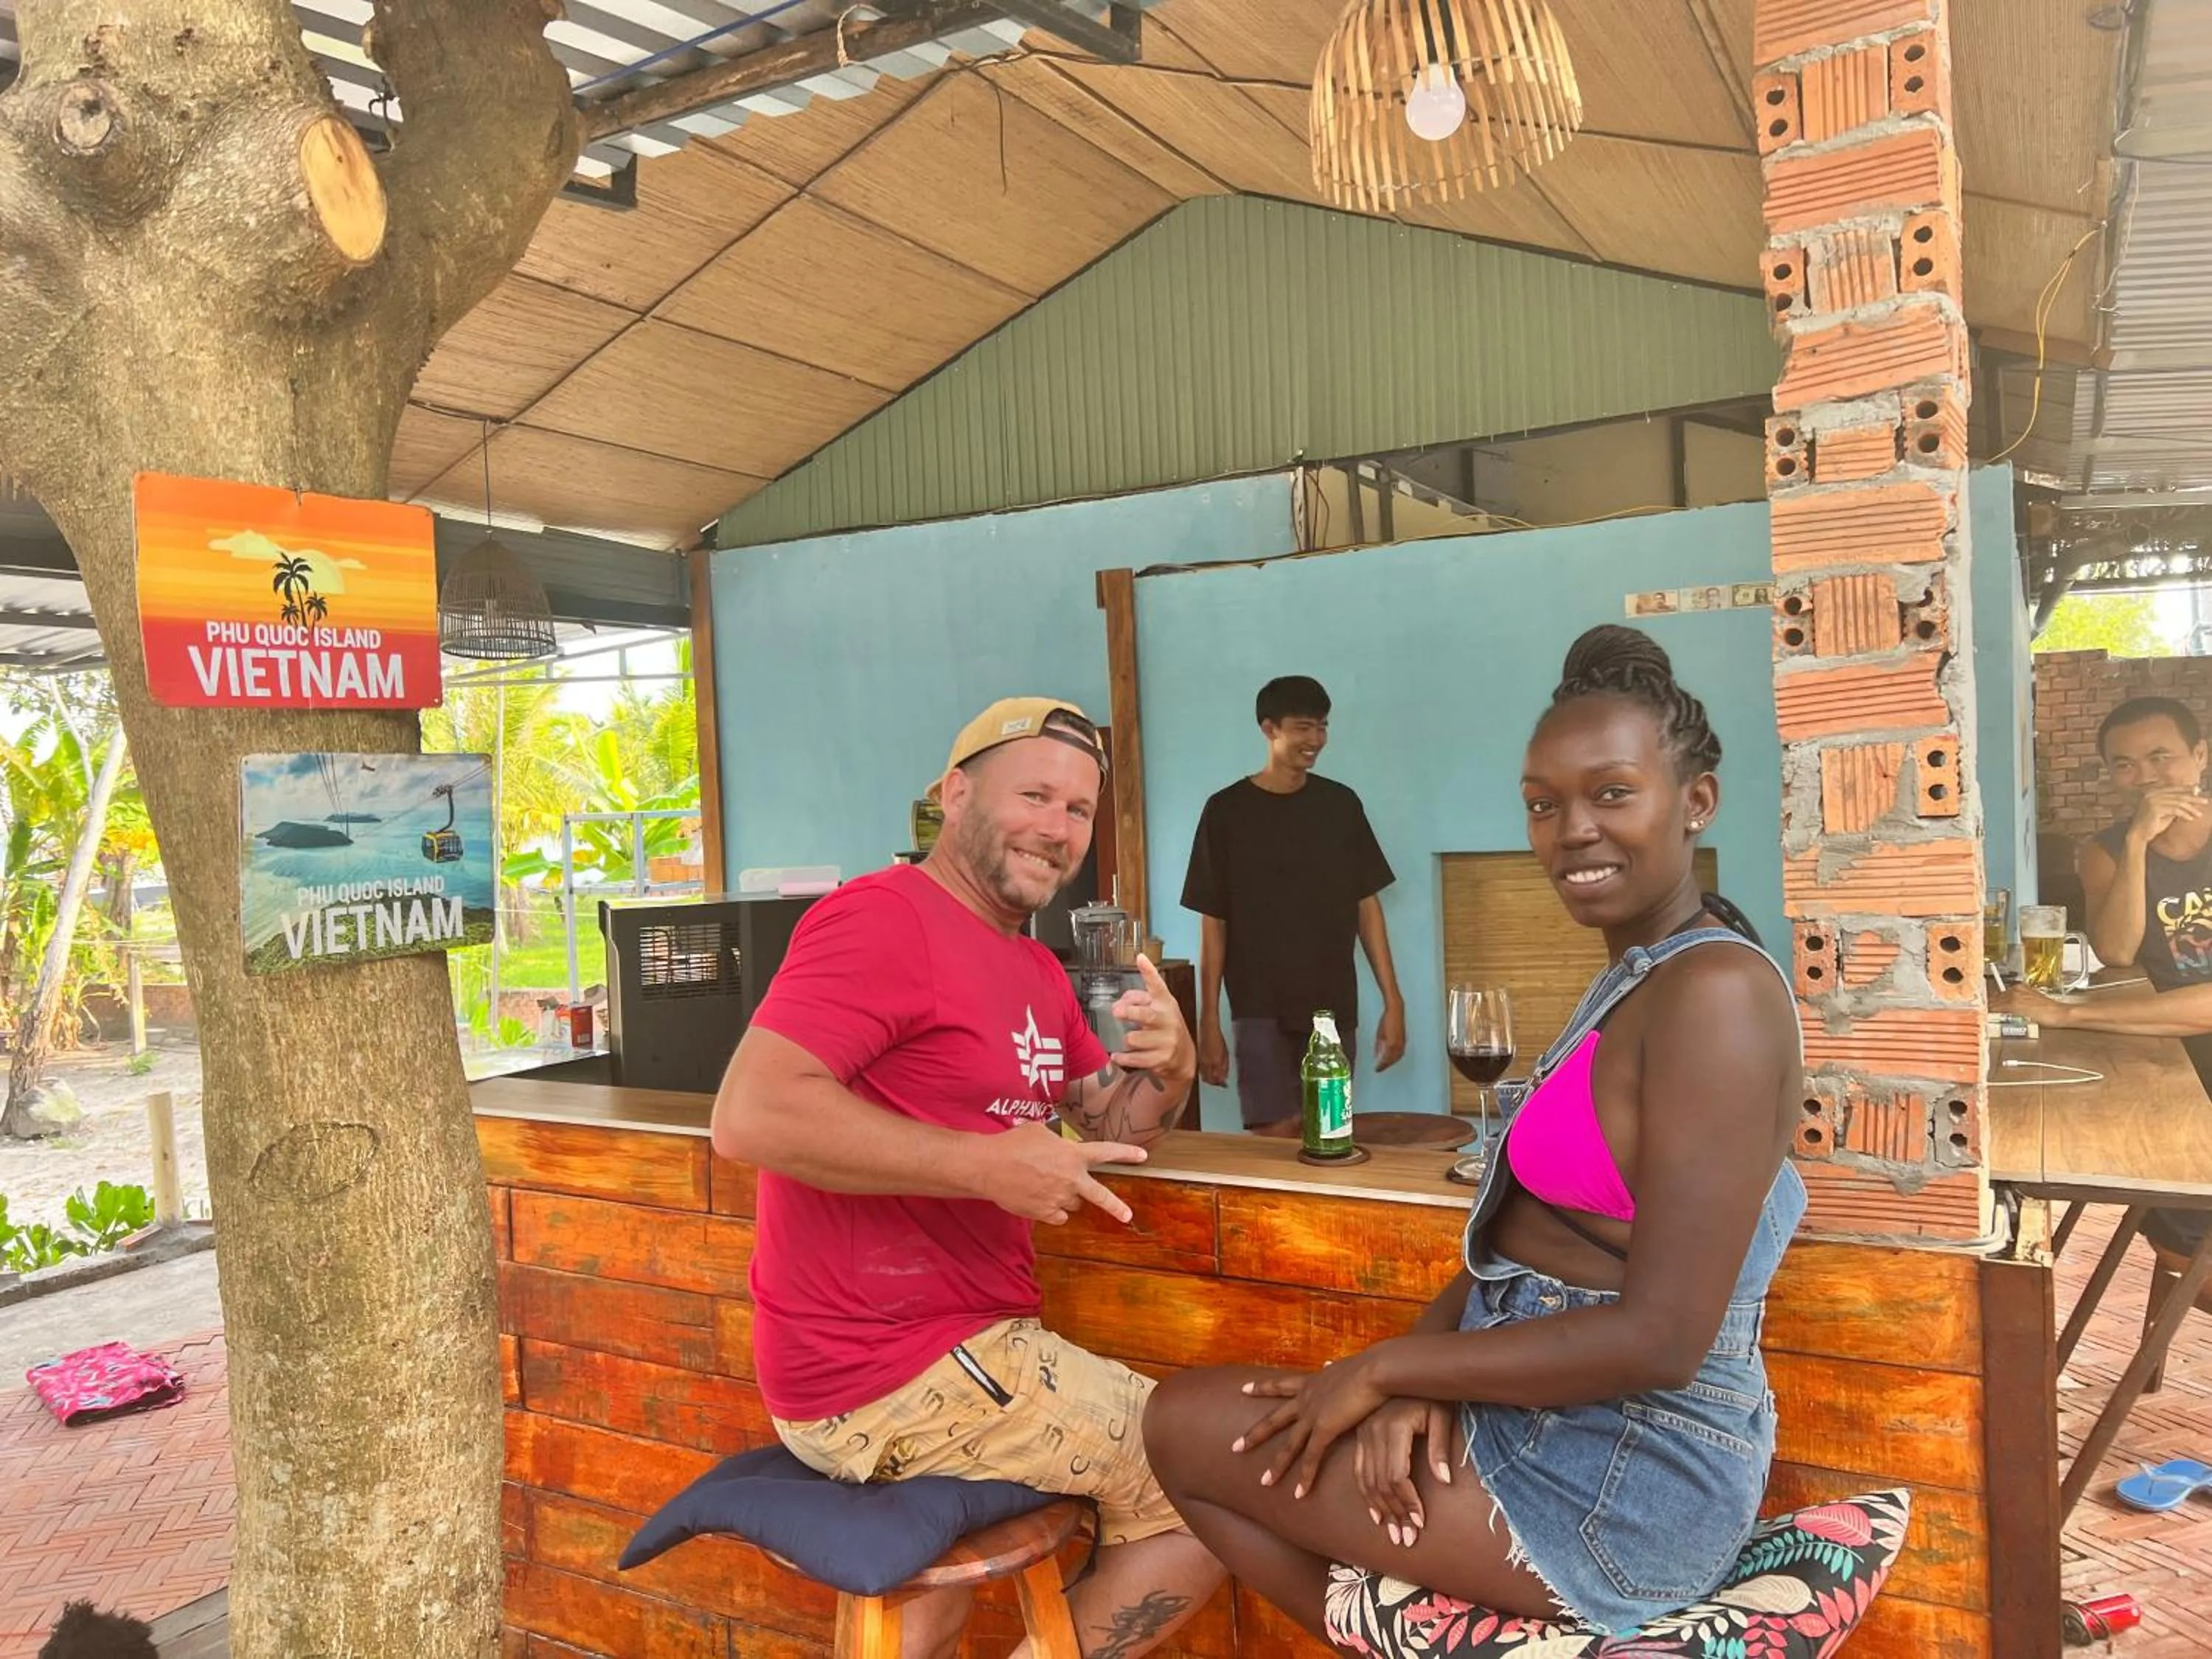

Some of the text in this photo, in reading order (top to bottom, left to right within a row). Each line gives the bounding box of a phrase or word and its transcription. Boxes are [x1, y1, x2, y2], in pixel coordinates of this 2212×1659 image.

[206, 620, 382, 650] PHU QUOC ISLAND
[187, 645, 405, 698] VIETNAM
[297, 875, 445, 907] PHU QUOC ISLAND
[280, 896, 465, 959] VIETNAM
